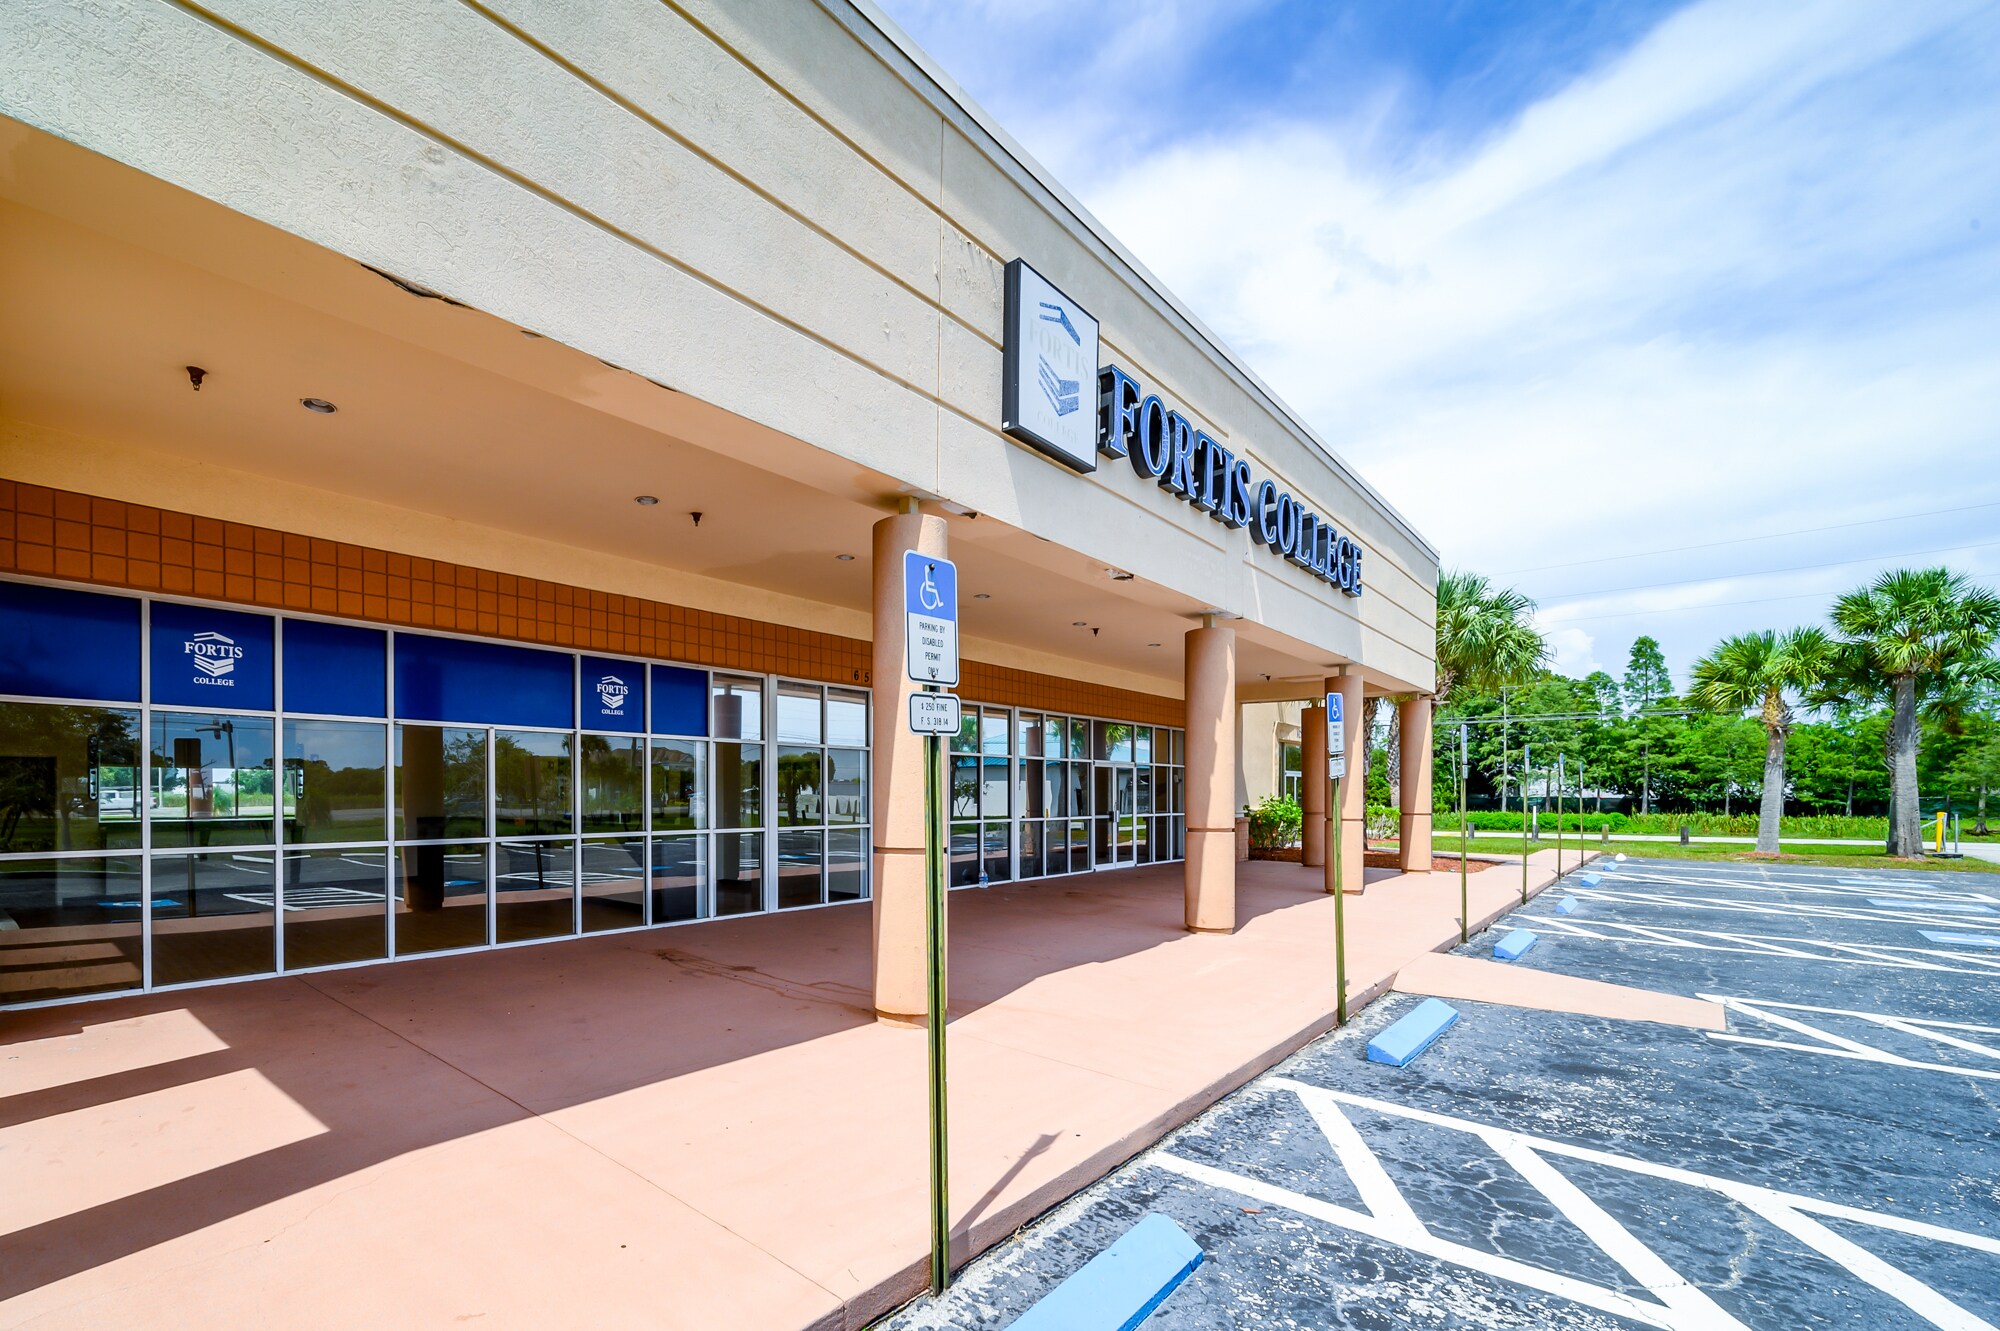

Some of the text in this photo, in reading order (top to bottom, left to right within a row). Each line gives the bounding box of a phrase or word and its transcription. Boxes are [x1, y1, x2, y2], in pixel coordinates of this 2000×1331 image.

[1029, 318, 1089, 380] FORTIS
[1108, 364, 1363, 597] FORTIS COLLEGE
[919, 621, 946, 635] PARKING BY
[921, 636, 944, 648] DISABLED
[184, 641, 243, 658] FORTIS
[924, 651, 941, 662] PERMIT
[193, 677, 235, 687] COLLEGE
[596, 683, 629, 695] FORTIS
[601, 708, 624, 716] COLLEGE
[936, 703, 948, 712] FINE
